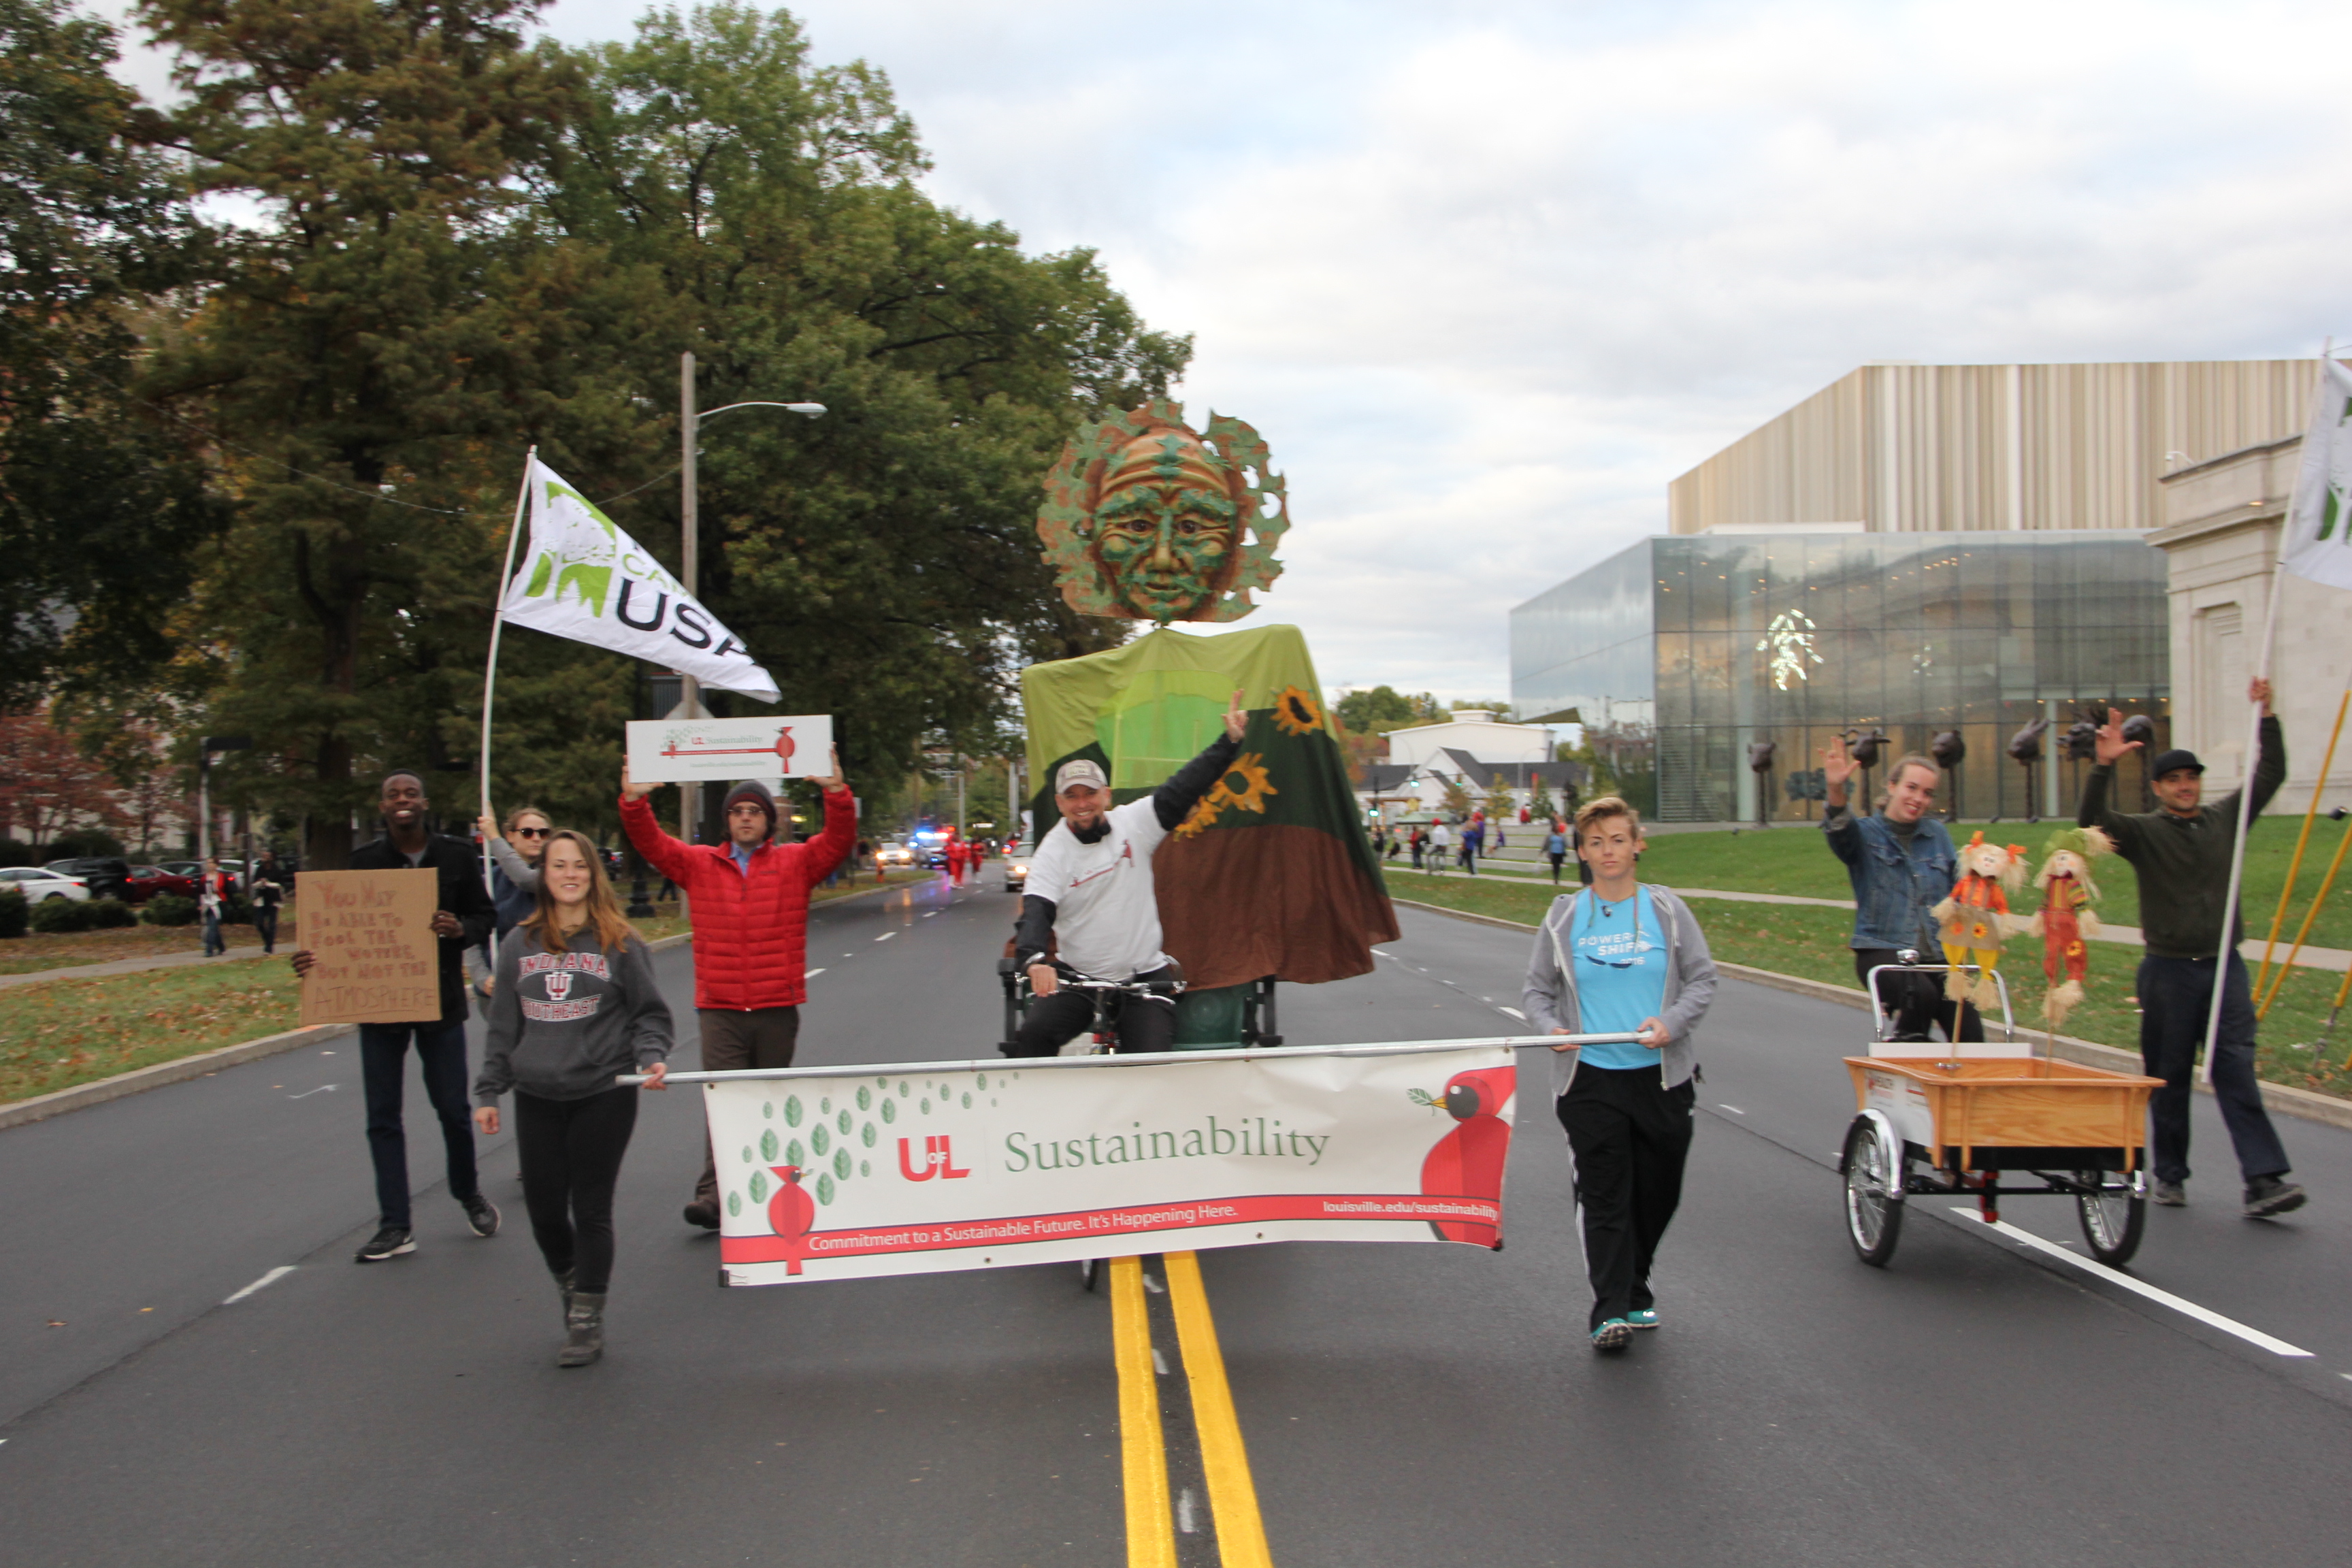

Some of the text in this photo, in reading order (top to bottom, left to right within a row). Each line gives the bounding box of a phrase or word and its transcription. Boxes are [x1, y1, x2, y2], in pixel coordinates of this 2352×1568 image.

[363, 930, 397, 945] THE
[1578, 932, 1634, 947] POWER
[518, 952, 612, 982] INDIANA
[314, 985, 436, 1015] ATMOSPHERE
[1004, 1115, 1330, 1173] Sustainability
[1323, 1201, 1498, 1222] louisville.edu/sustainability
[809, 1231, 910, 1251] Commitment
[913, 1230, 930, 1243] to
[932, 1232, 943, 1242] a
[944, 1222, 1032, 1241] Sustainable
[1034, 1218, 1087, 1235] Future.
[1113, 1207, 1196, 1228] Happening
[1198, 1204, 1239, 1219] Here.
